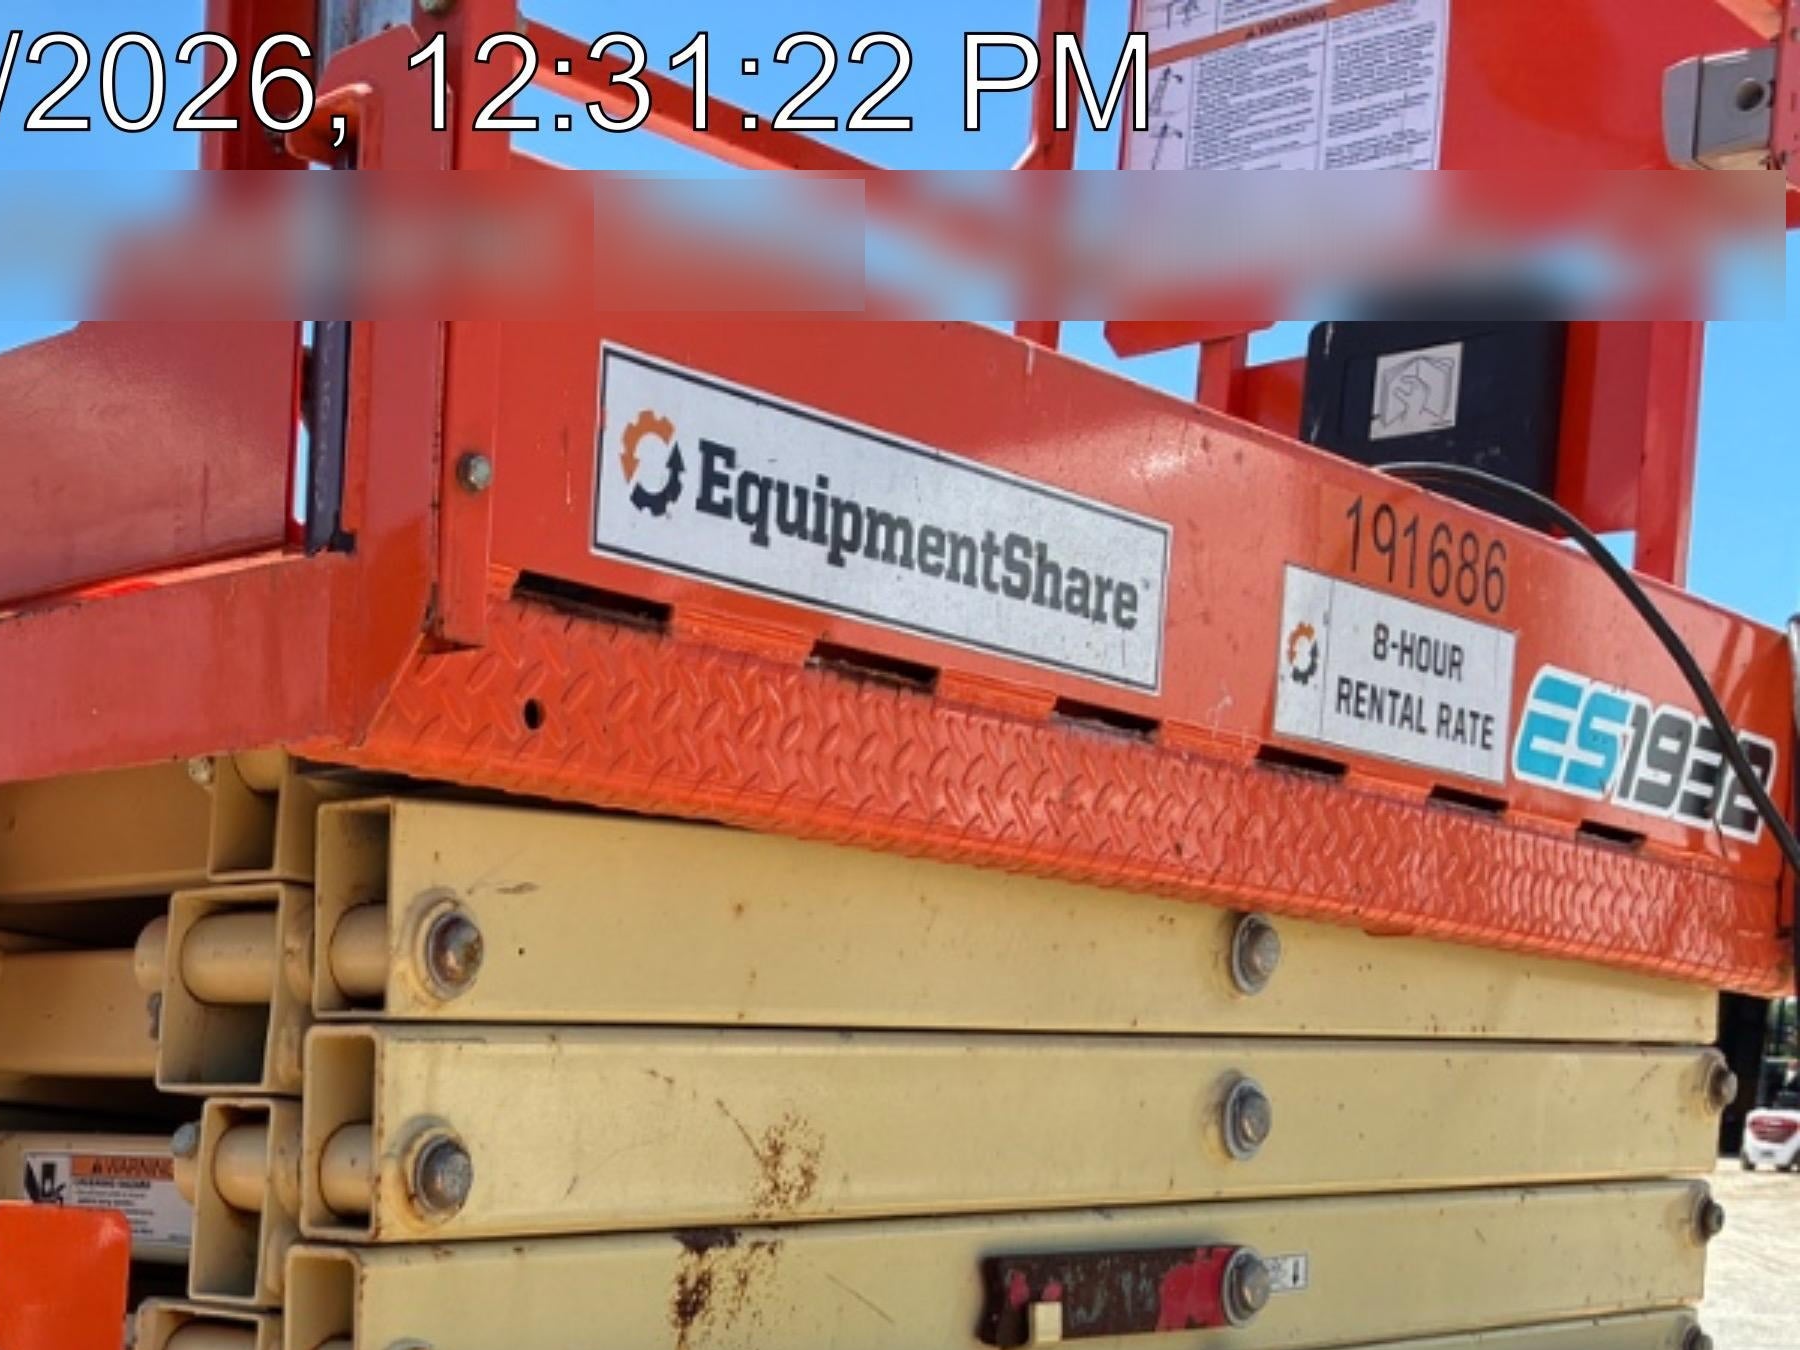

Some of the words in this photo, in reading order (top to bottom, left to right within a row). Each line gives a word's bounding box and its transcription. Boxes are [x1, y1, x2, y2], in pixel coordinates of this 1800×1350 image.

[696, 438, 1140, 631] EquipmentShare
[1346, 495, 1508, 614] 191686
[1372, 622, 1465, 682] 8-HOUR
[1335, 676, 1428, 736] RENTAL
[1438, 703, 1496, 752] RATE
